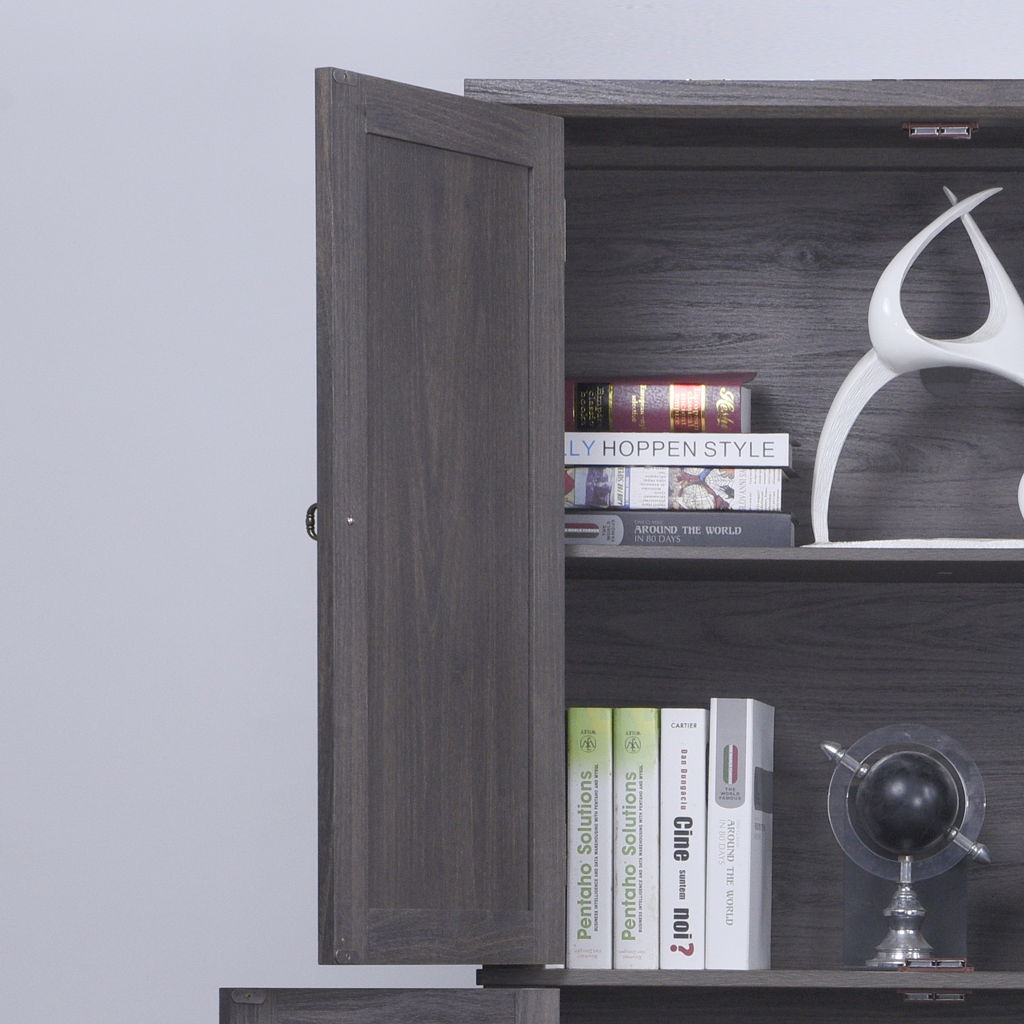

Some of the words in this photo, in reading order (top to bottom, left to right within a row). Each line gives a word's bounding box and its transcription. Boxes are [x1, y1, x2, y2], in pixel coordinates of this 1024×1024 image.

[564, 441, 596, 456] LY
[603, 440, 697, 458] HOPPEN
[704, 441, 775, 458] STYLE
[634, 525, 678, 534] AROUND
[682, 526, 702, 535] THE
[705, 526, 742, 535] WORLD
[634, 535, 644, 543] IN
[646, 535, 657, 543] 80
[658, 535, 681, 544] DAYS
[680, 749, 688, 765] Dan
[577, 770, 592, 855] Solutions
[621, 772, 637, 855] Solutions
[719, 819, 726, 829] IN
[673, 816, 693, 861] Cine
[727, 819, 736, 862] AROUND
[718, 843, 726, 865] DAYS
[726, 867, 735, 886] THE
[577, 863, 592, 940] Pentaho
[621, 864, 637, 941] Pentaho
[725, 890, 734, 926] WORLD
